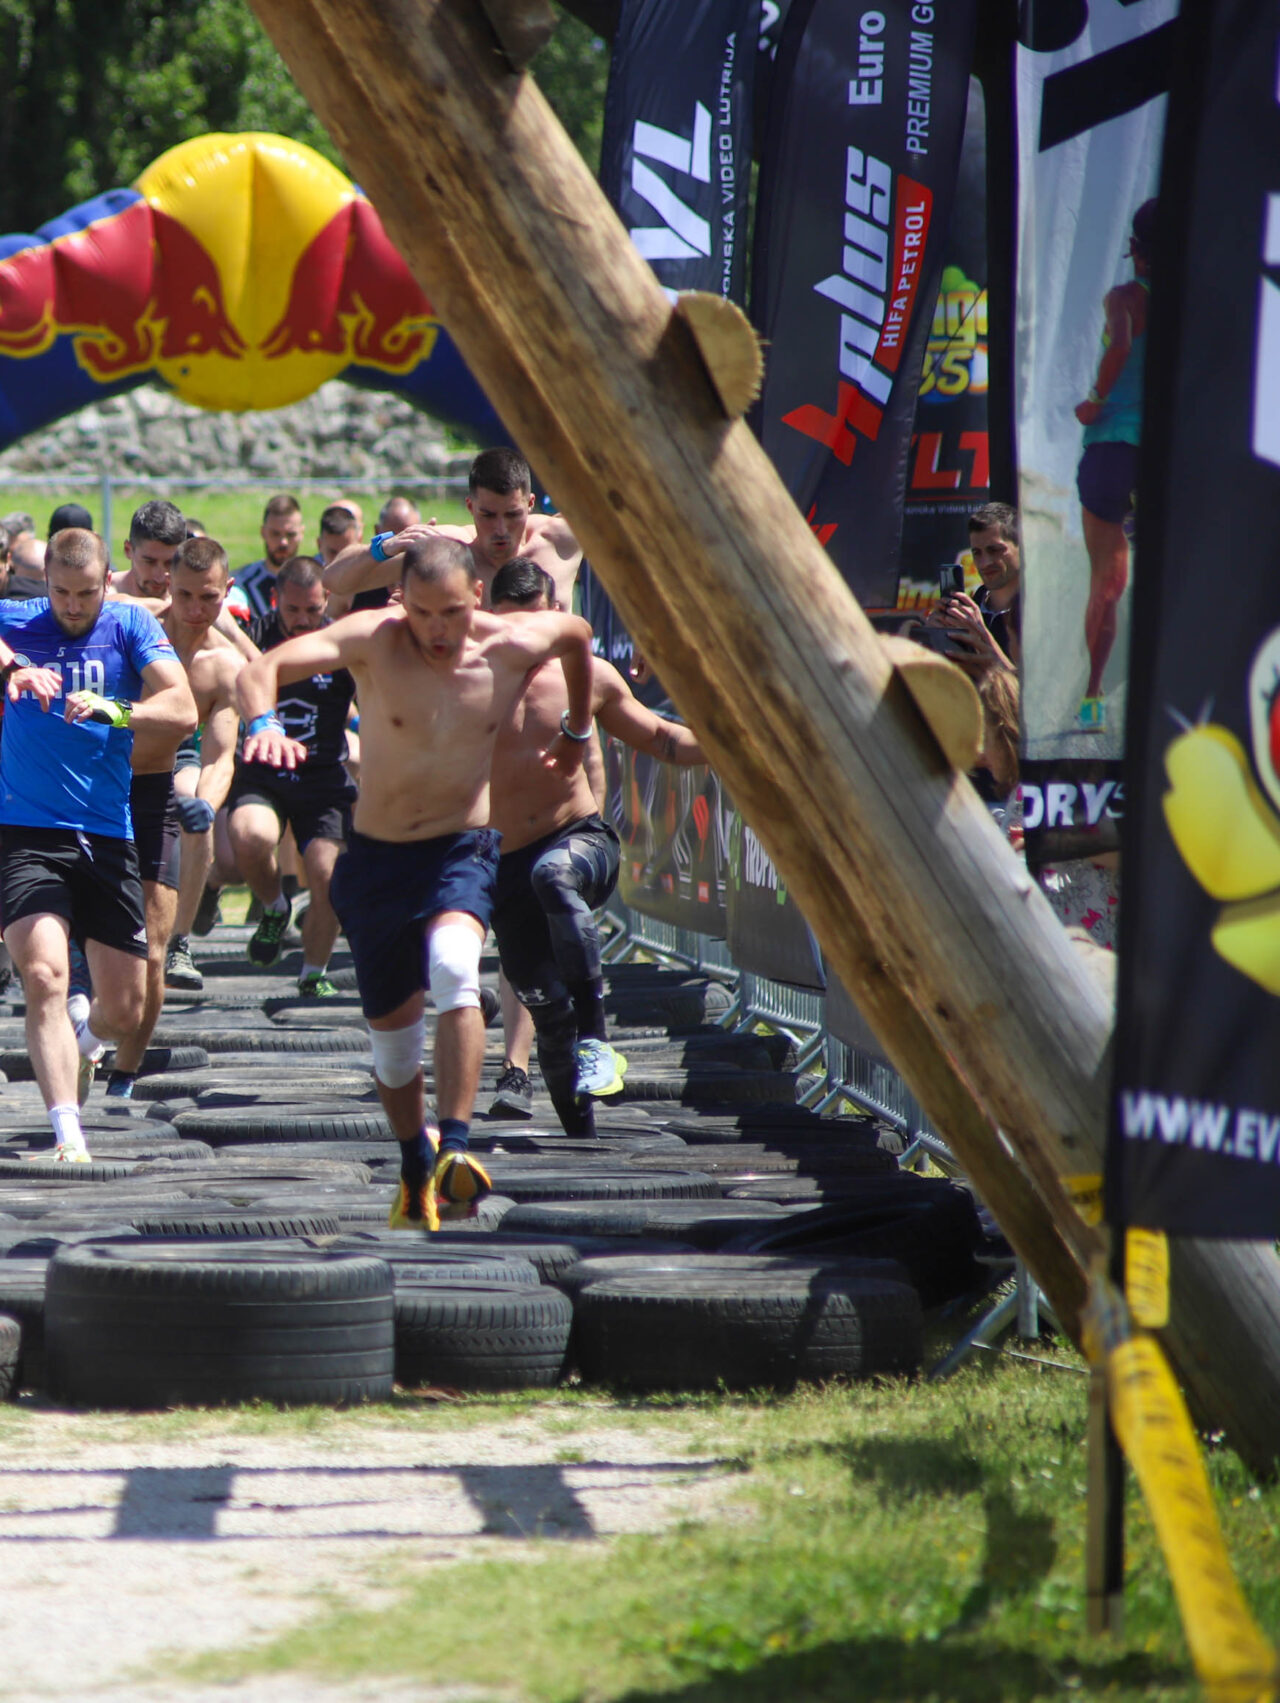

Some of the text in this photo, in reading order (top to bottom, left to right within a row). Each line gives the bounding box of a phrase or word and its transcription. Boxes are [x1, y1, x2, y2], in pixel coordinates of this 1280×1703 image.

[719, 31, 737, 126] LUTRIJA
[848, 10, 886, 105] Euro
[906, 30, 934, 155] PREMIUM
[719, 134, 735, 205] VIDEO
[882, 201, 926, 348] HIFA PETROL
